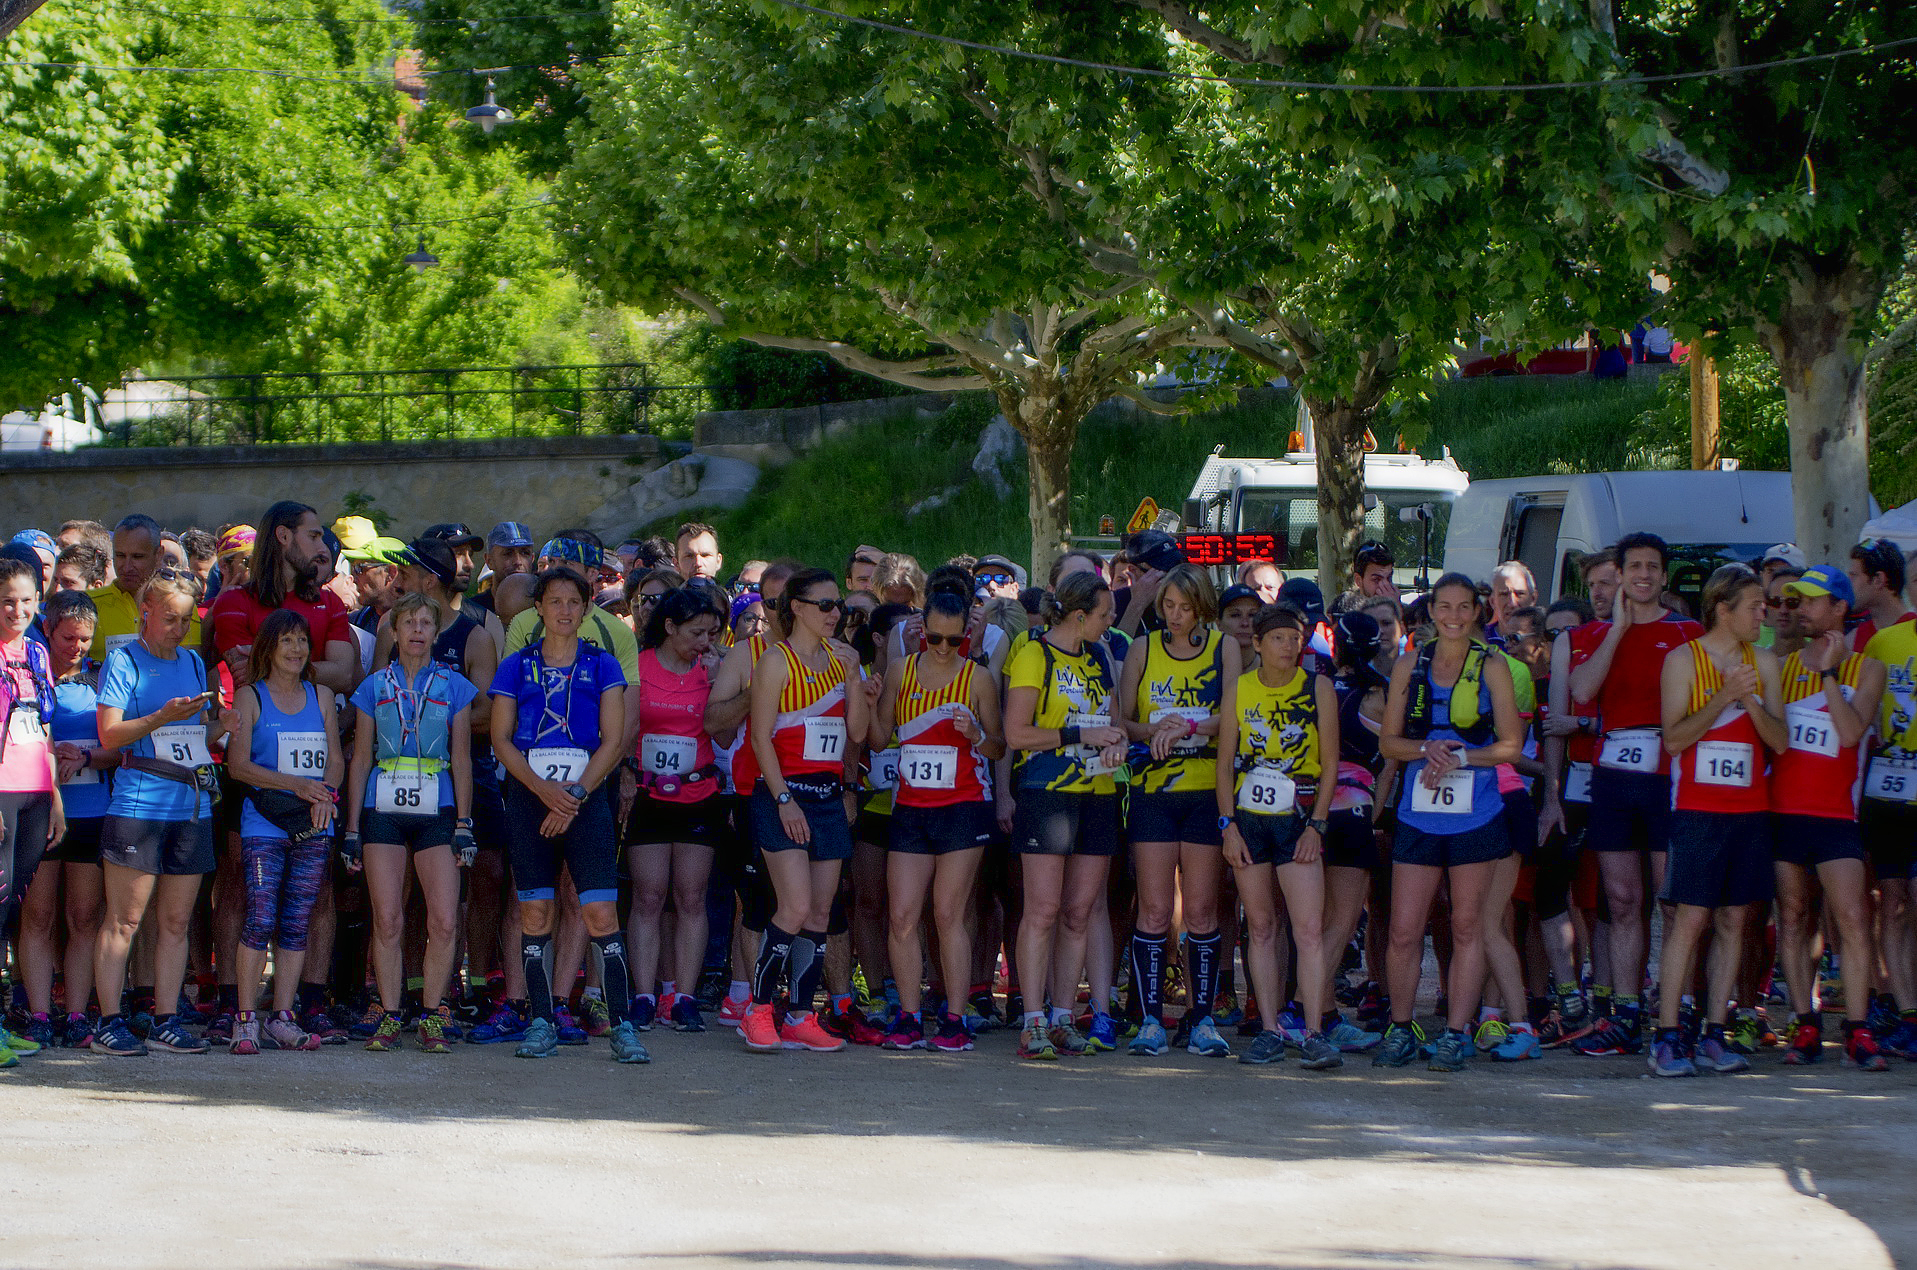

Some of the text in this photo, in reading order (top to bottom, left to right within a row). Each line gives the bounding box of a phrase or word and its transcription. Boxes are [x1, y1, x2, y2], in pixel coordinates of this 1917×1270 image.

[820, 734, 838, 754] 77
[1793, 723, 1829, 747] 161
[171, 743, 192, 761] 51
[290, 749, 325, 769] 136
[655, 751, 679, 771] 94
[1617, 747, 1642, 764] 26
[545, 764, 571, 781] 27
[909, 761, 942, 780] 131
[1708, 758, 1744, 779] 164
[1881, 775, 1906, 793] 55
[394, 787, 420, 807] 85
[1252, 784, 1276, 805] 93
[1431, 786, 1454, 806] 76
[1147, 944, 1162, 1004] kalenji
[1198, 944, 1213, 1005] kalenji
